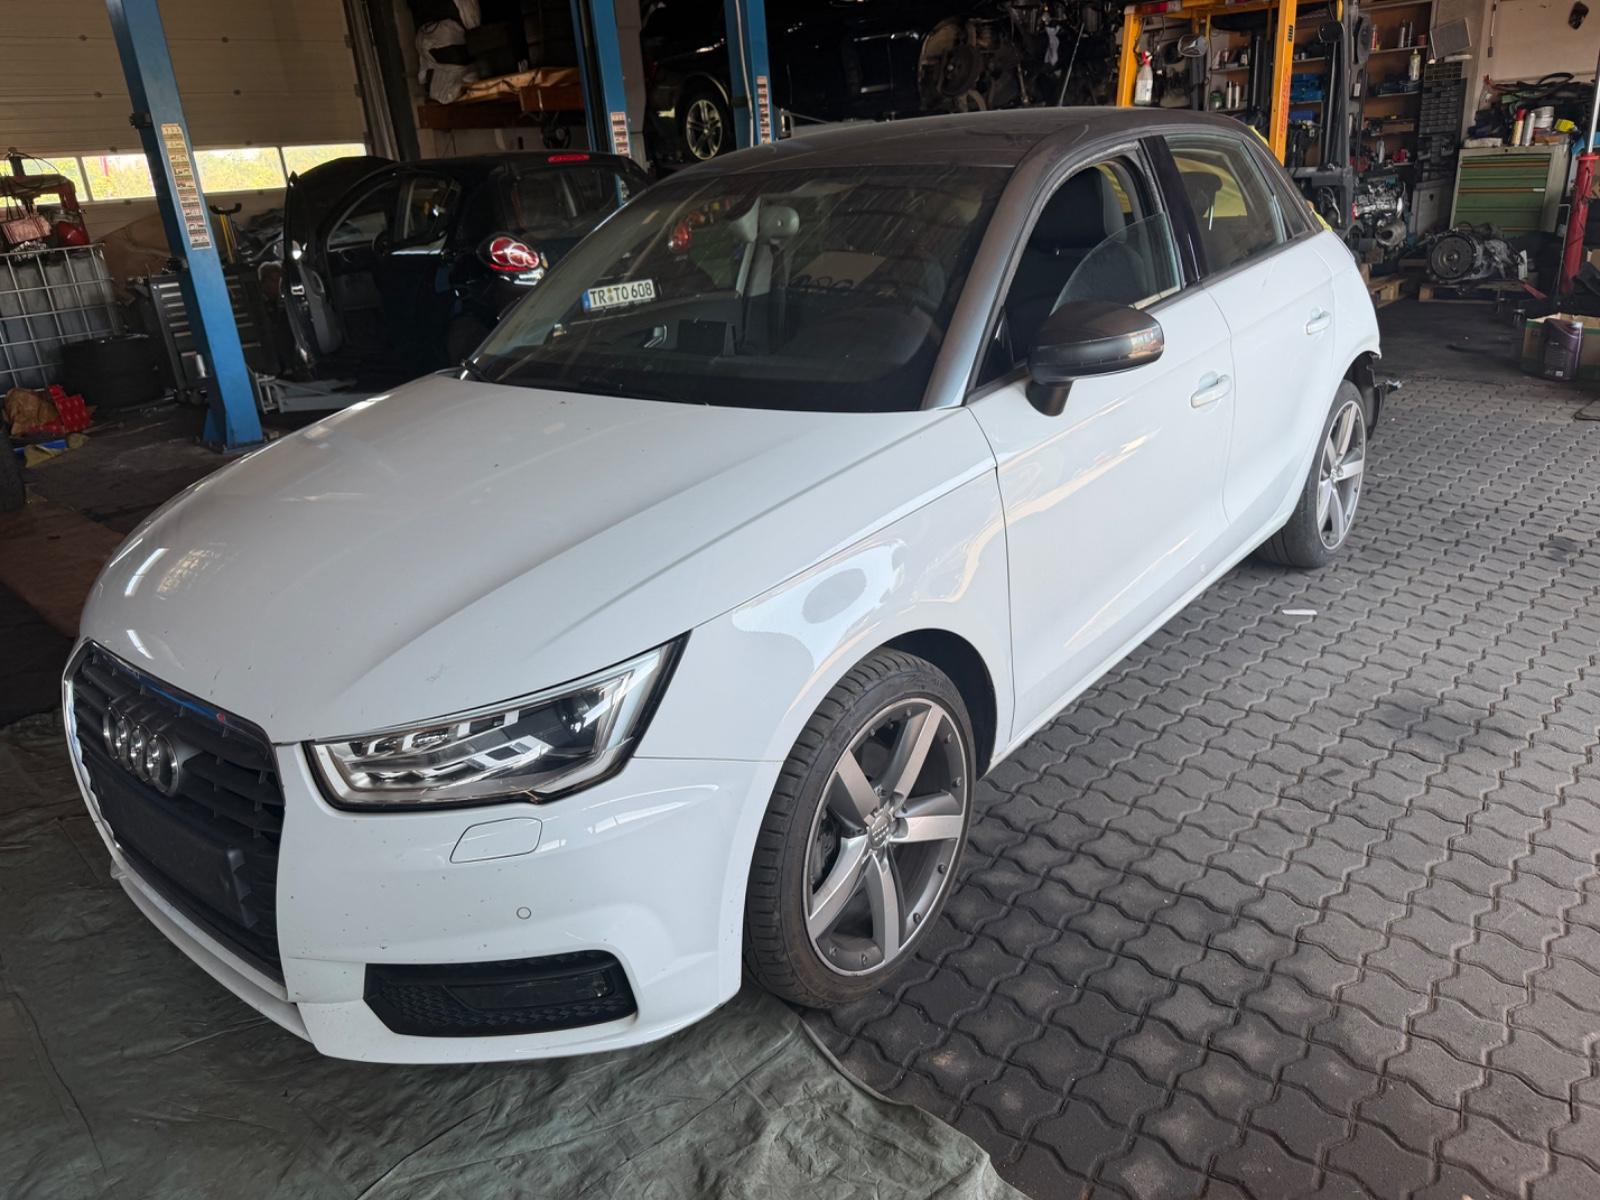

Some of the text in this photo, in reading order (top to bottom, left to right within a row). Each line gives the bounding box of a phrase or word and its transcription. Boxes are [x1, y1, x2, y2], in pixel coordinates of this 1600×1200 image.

[590, 282, 653, 305] TR TO 608
